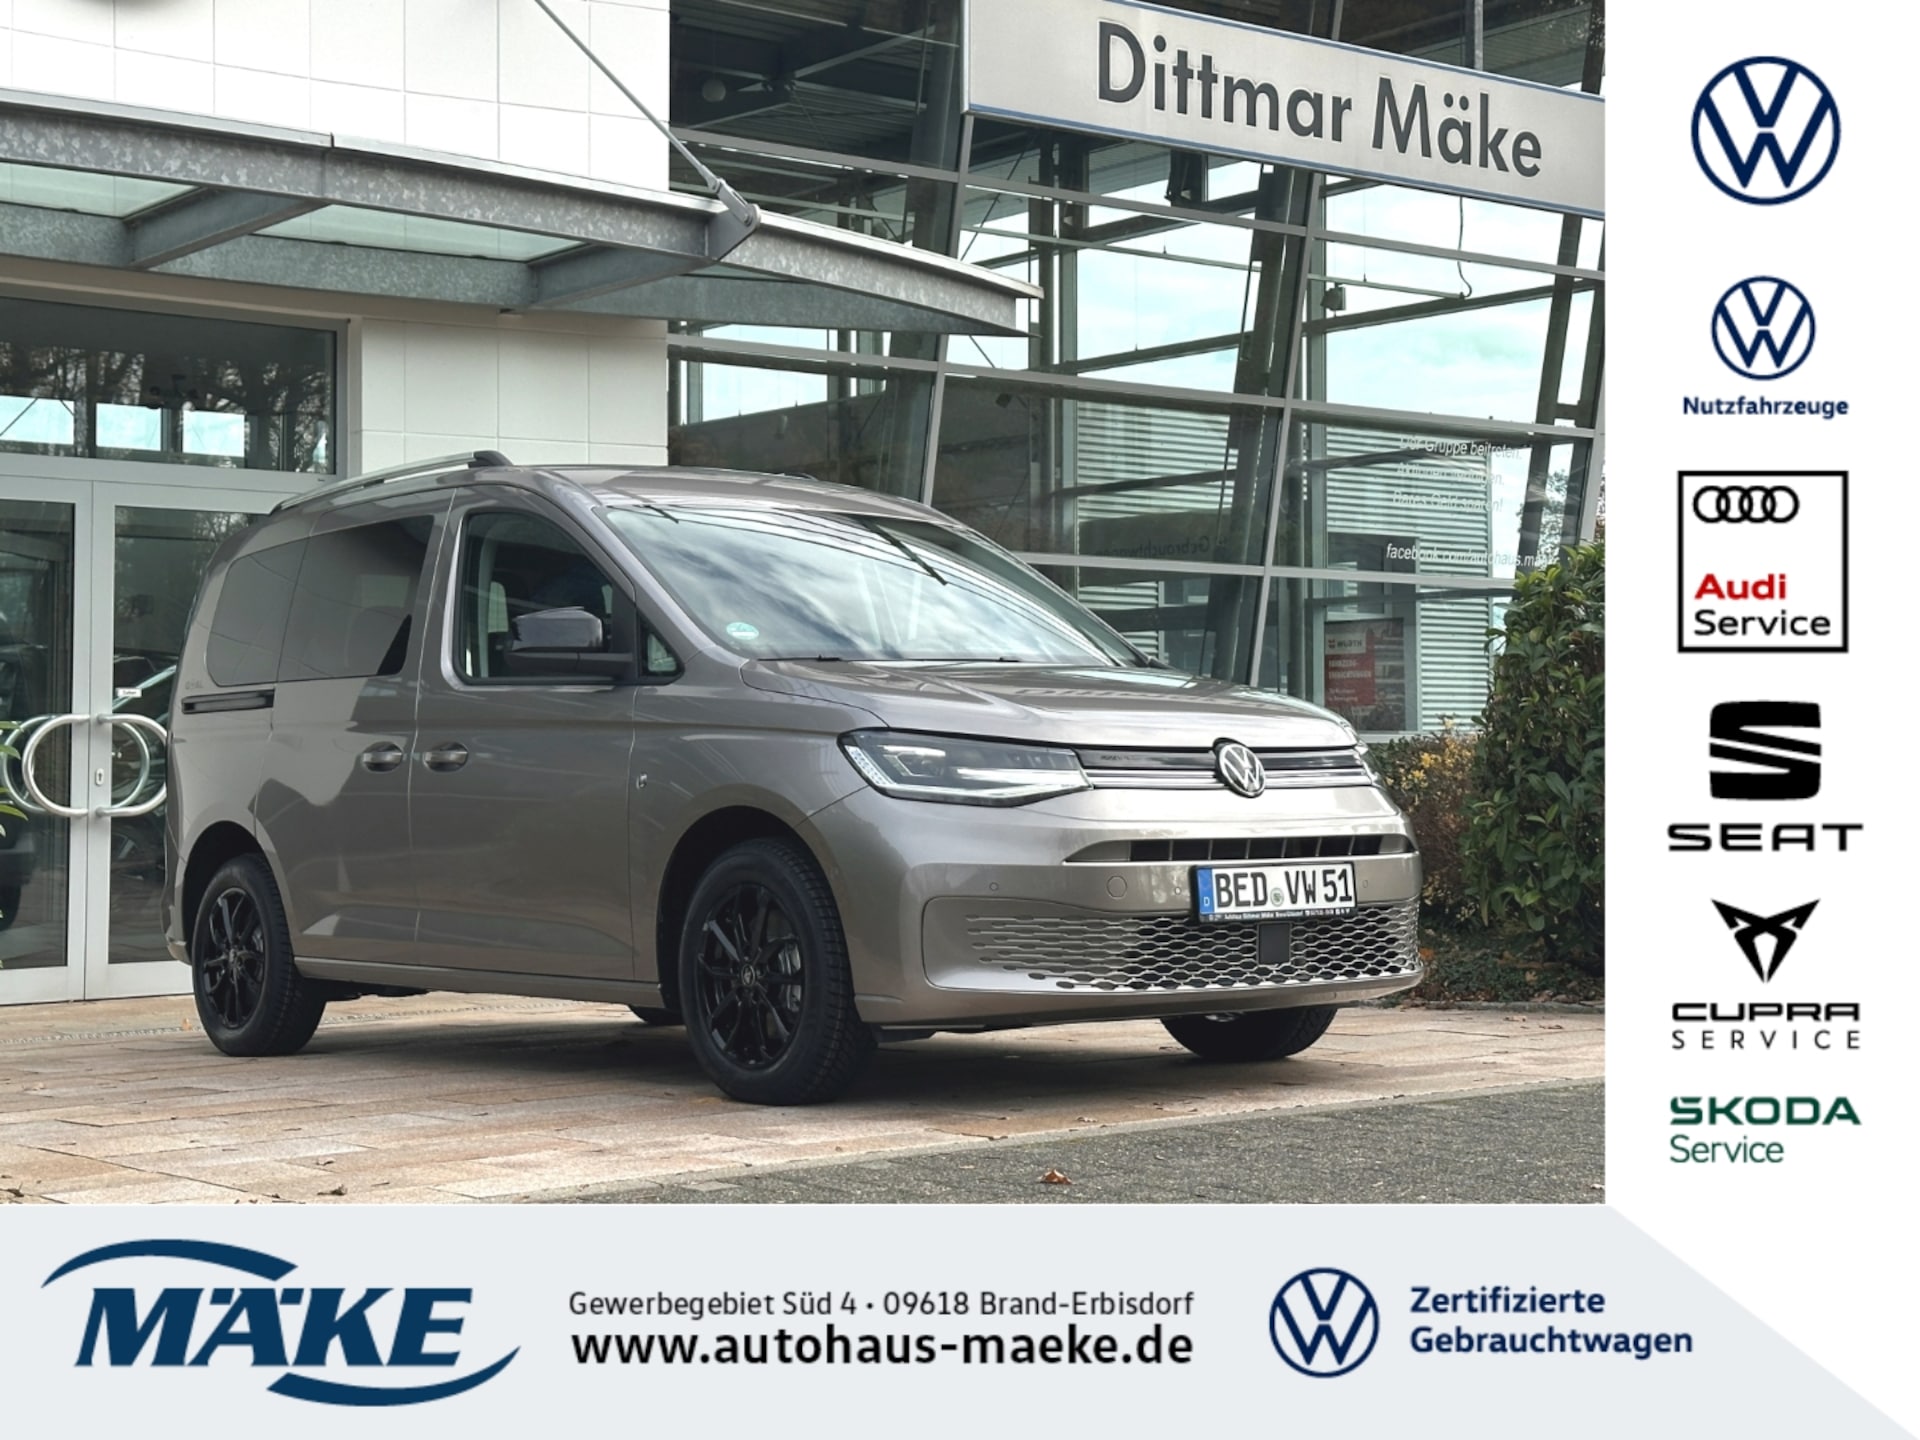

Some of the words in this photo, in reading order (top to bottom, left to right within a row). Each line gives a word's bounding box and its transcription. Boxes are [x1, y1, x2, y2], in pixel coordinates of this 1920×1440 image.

[1098, 20, 1352, 143] Dittmar
[1372, 77, 1542, 178] Mäke
[1424, 437, 1467, 457] Gruppe
[1214, 871, 1268, 908] BED
[1285, 869, 1316, 905] VW
[1322, 868, 1353, 903] 51
